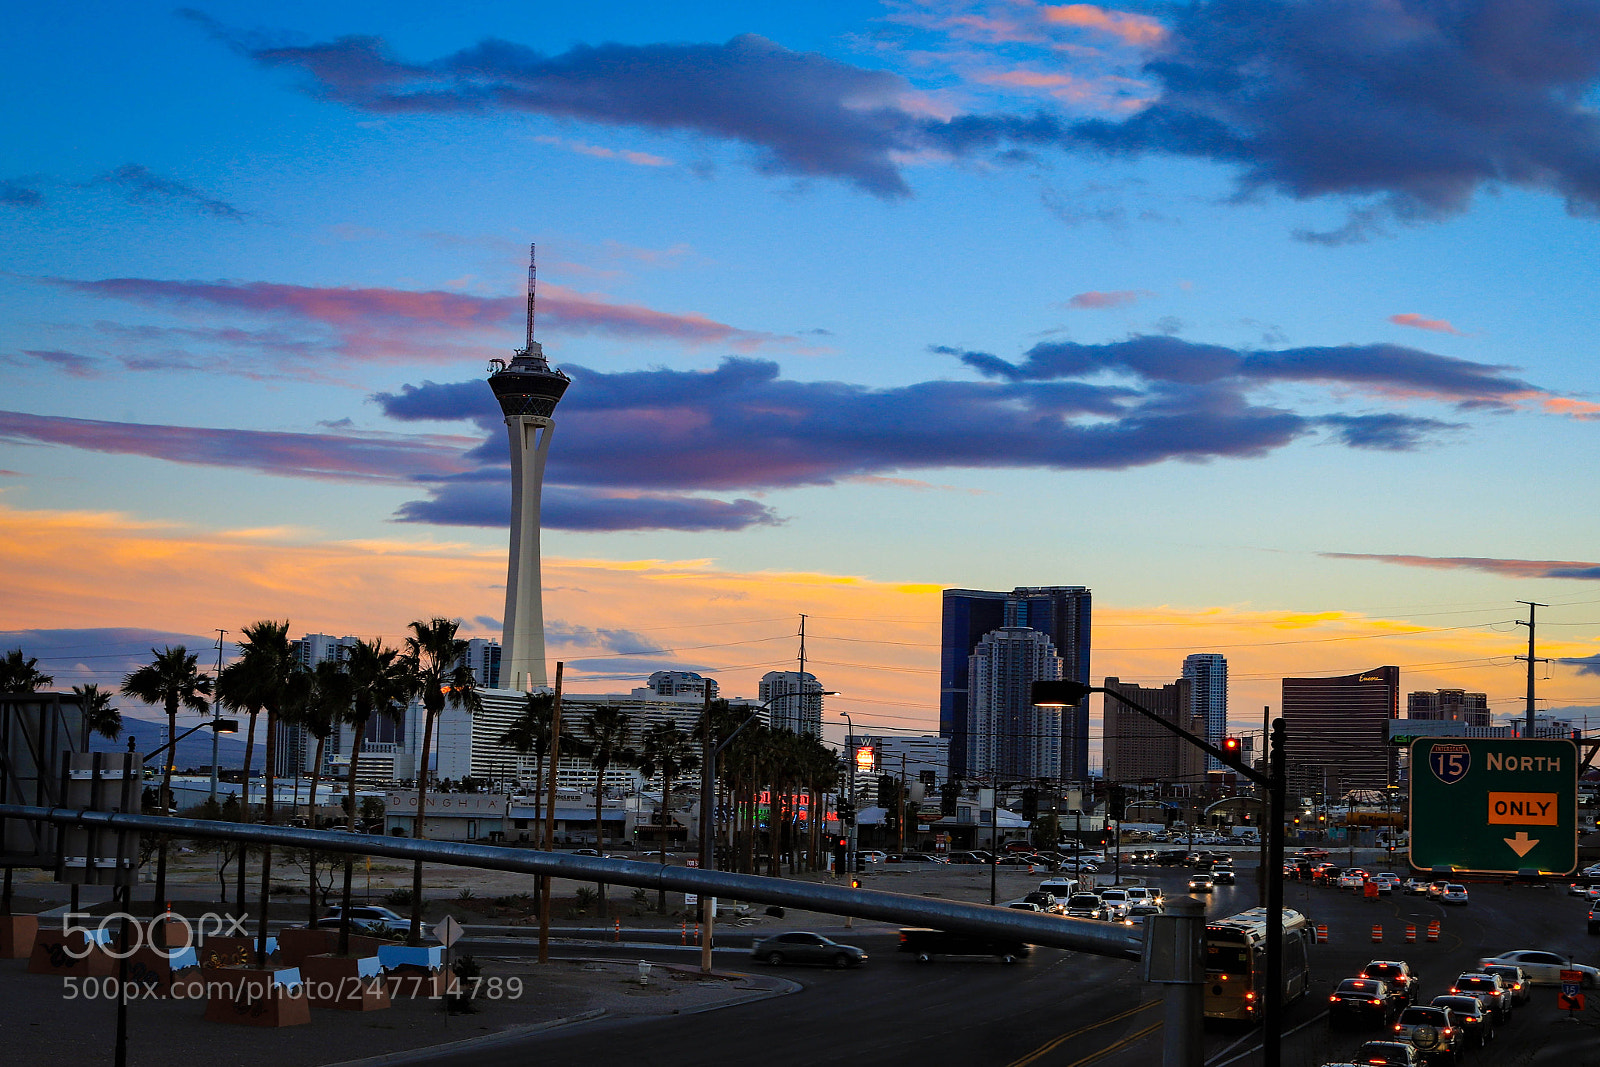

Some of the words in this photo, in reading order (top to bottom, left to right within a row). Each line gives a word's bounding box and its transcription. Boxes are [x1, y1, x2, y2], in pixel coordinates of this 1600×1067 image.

[1437, 754, 1463, 776] 15
[1486, 752, 1561, 772] NORTH
[393, 796, 496, 808] DONGHIA
[1494, 801, 1551, 817] ONLY
